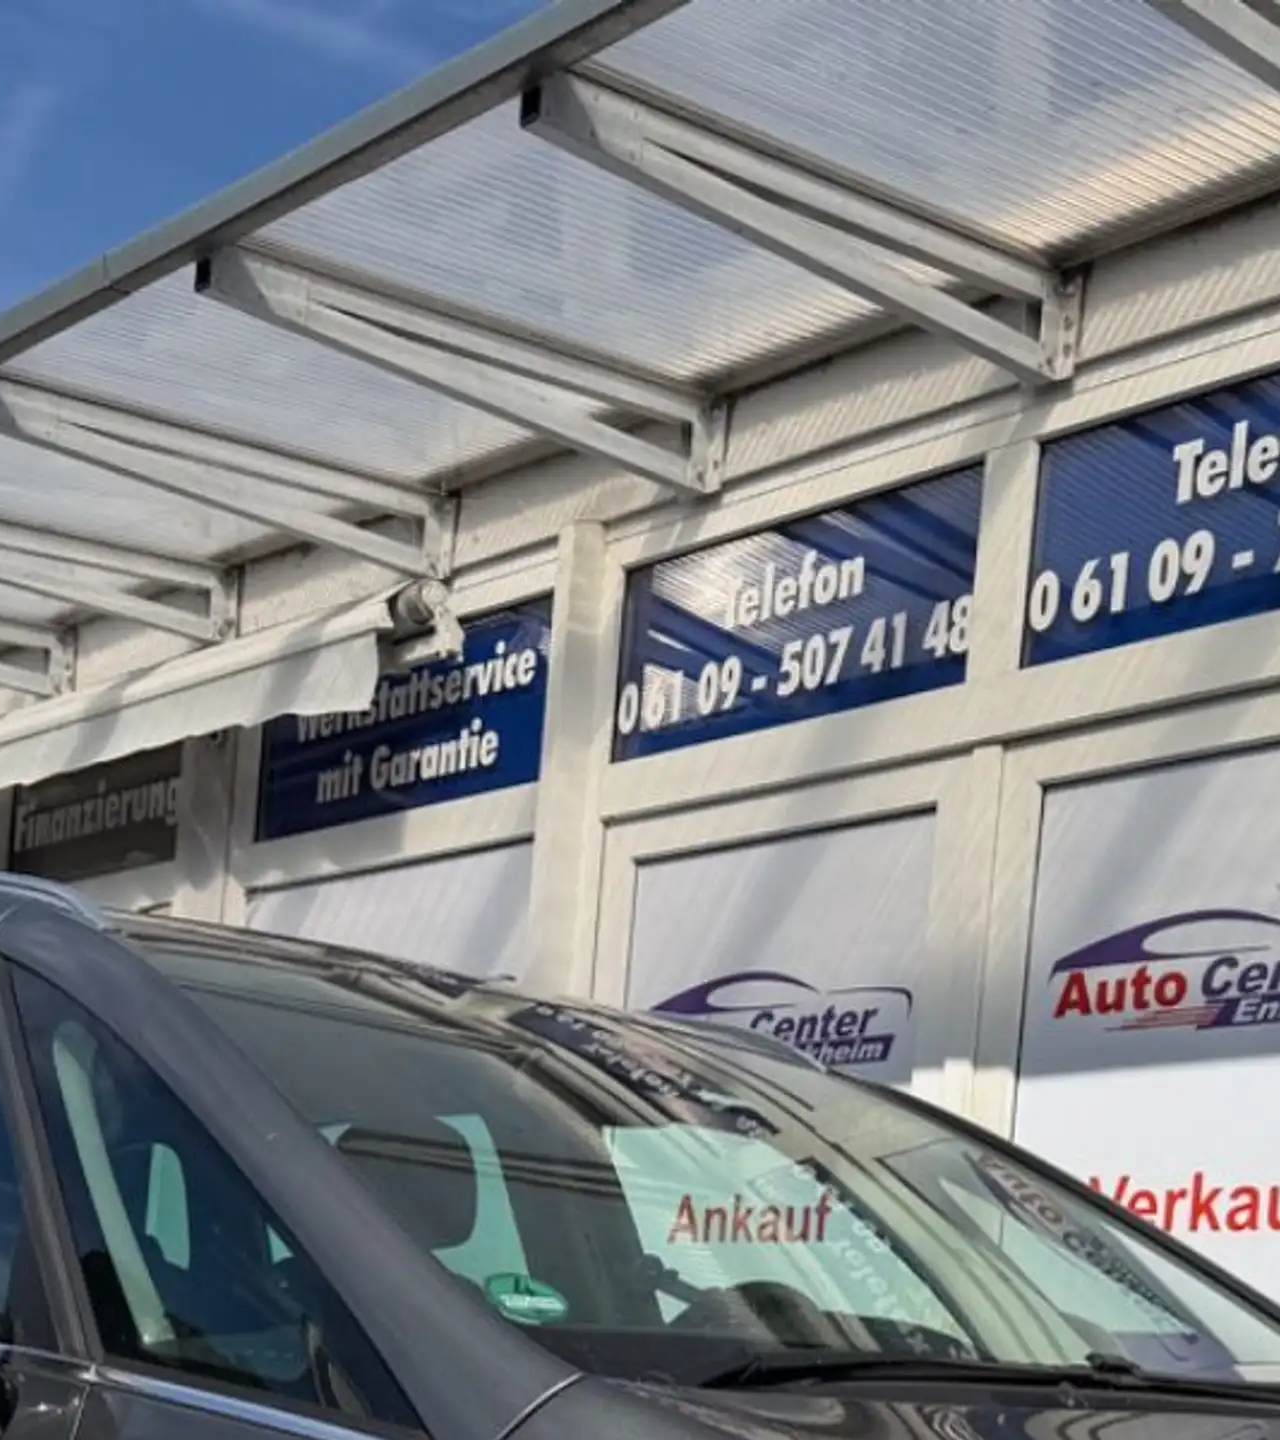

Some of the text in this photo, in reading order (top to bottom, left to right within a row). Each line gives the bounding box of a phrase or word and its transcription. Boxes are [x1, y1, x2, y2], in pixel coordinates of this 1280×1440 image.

[723, 549, 866, 630] Telefon
[1029, 570, 1060, 632] 0
[1071, 551, 1130, 623] 61
[1148, 529, 1216, 603] 09
[776, 625, 855, 698] 507
[860, 611, 908, 674] 41
[316, 717, 500, 804] mit Garantie
[1053, 965, 1188, 1019] Auto
[667, 1193, 834, 1246] Ankauf
